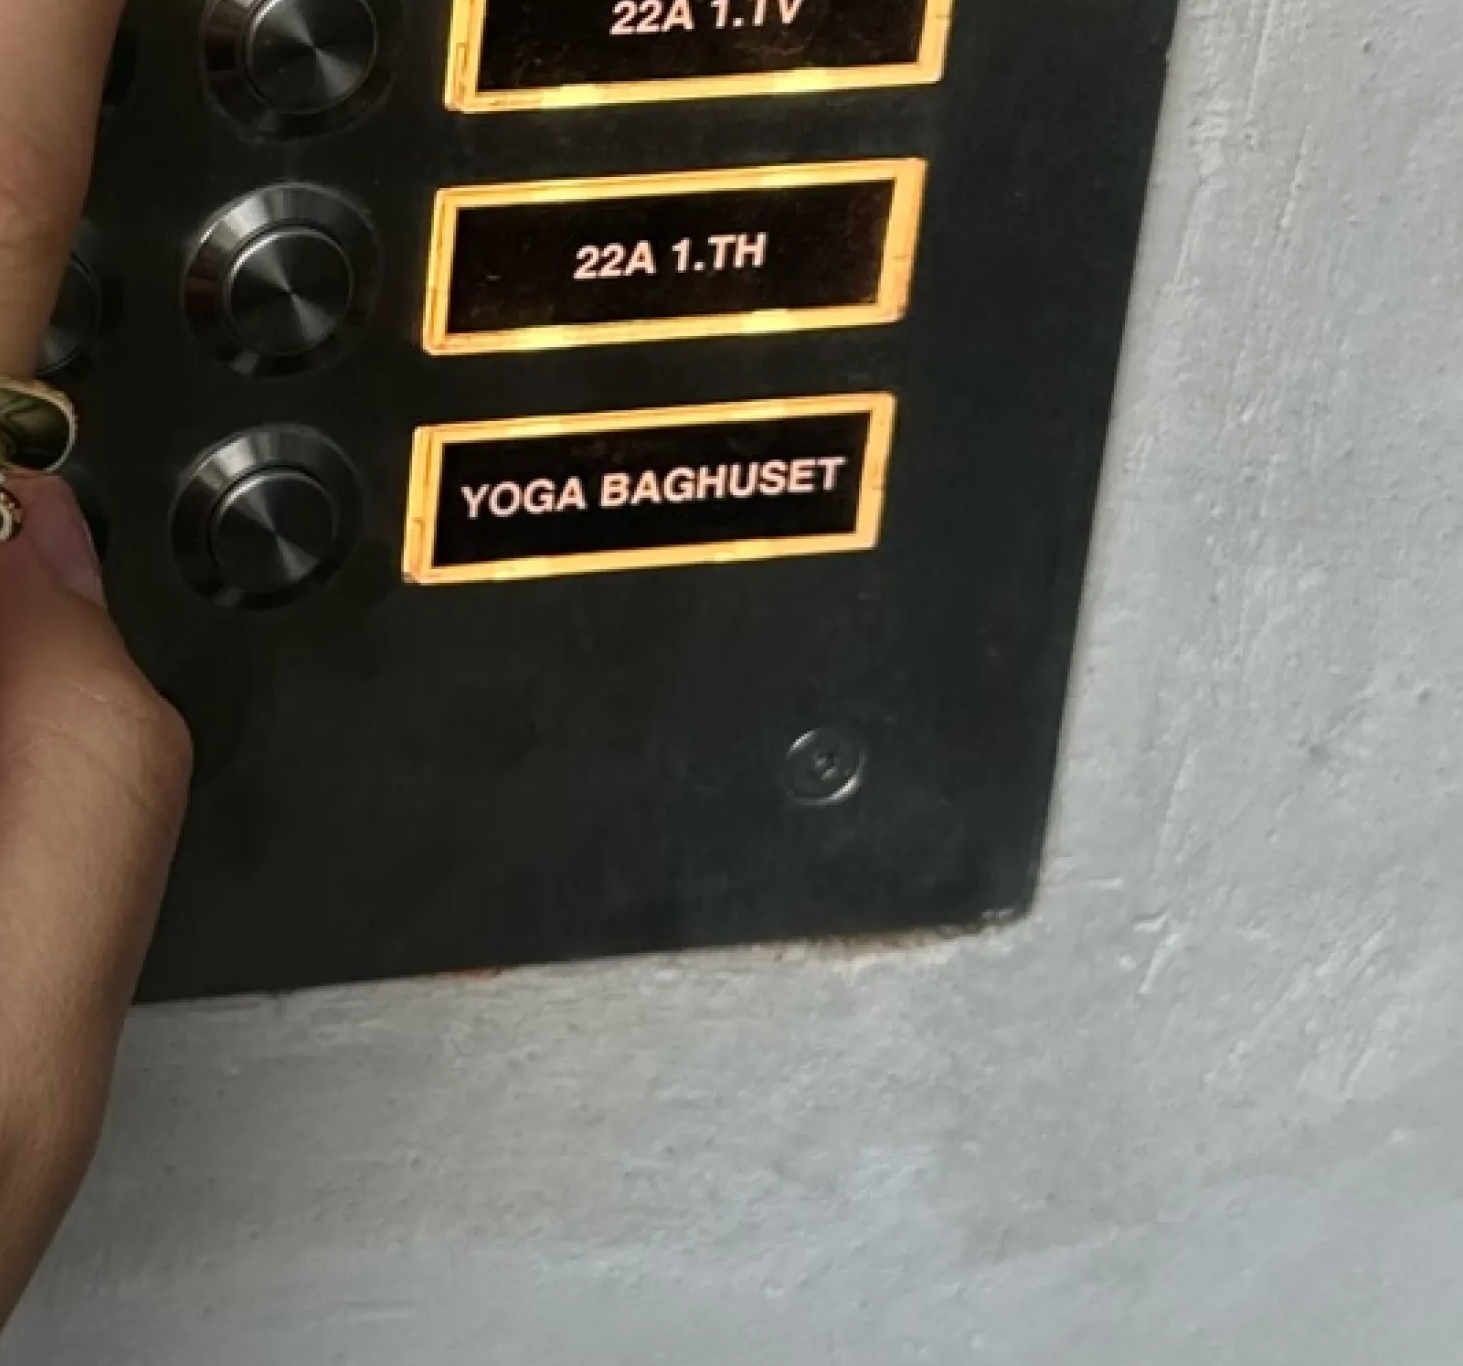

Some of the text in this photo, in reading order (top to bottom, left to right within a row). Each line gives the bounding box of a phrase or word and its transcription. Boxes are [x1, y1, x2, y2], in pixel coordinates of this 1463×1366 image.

[573, 231, 767, 280] 22A 1.TH
[461, 456, 846, 518] YOGA BAGHUSET
